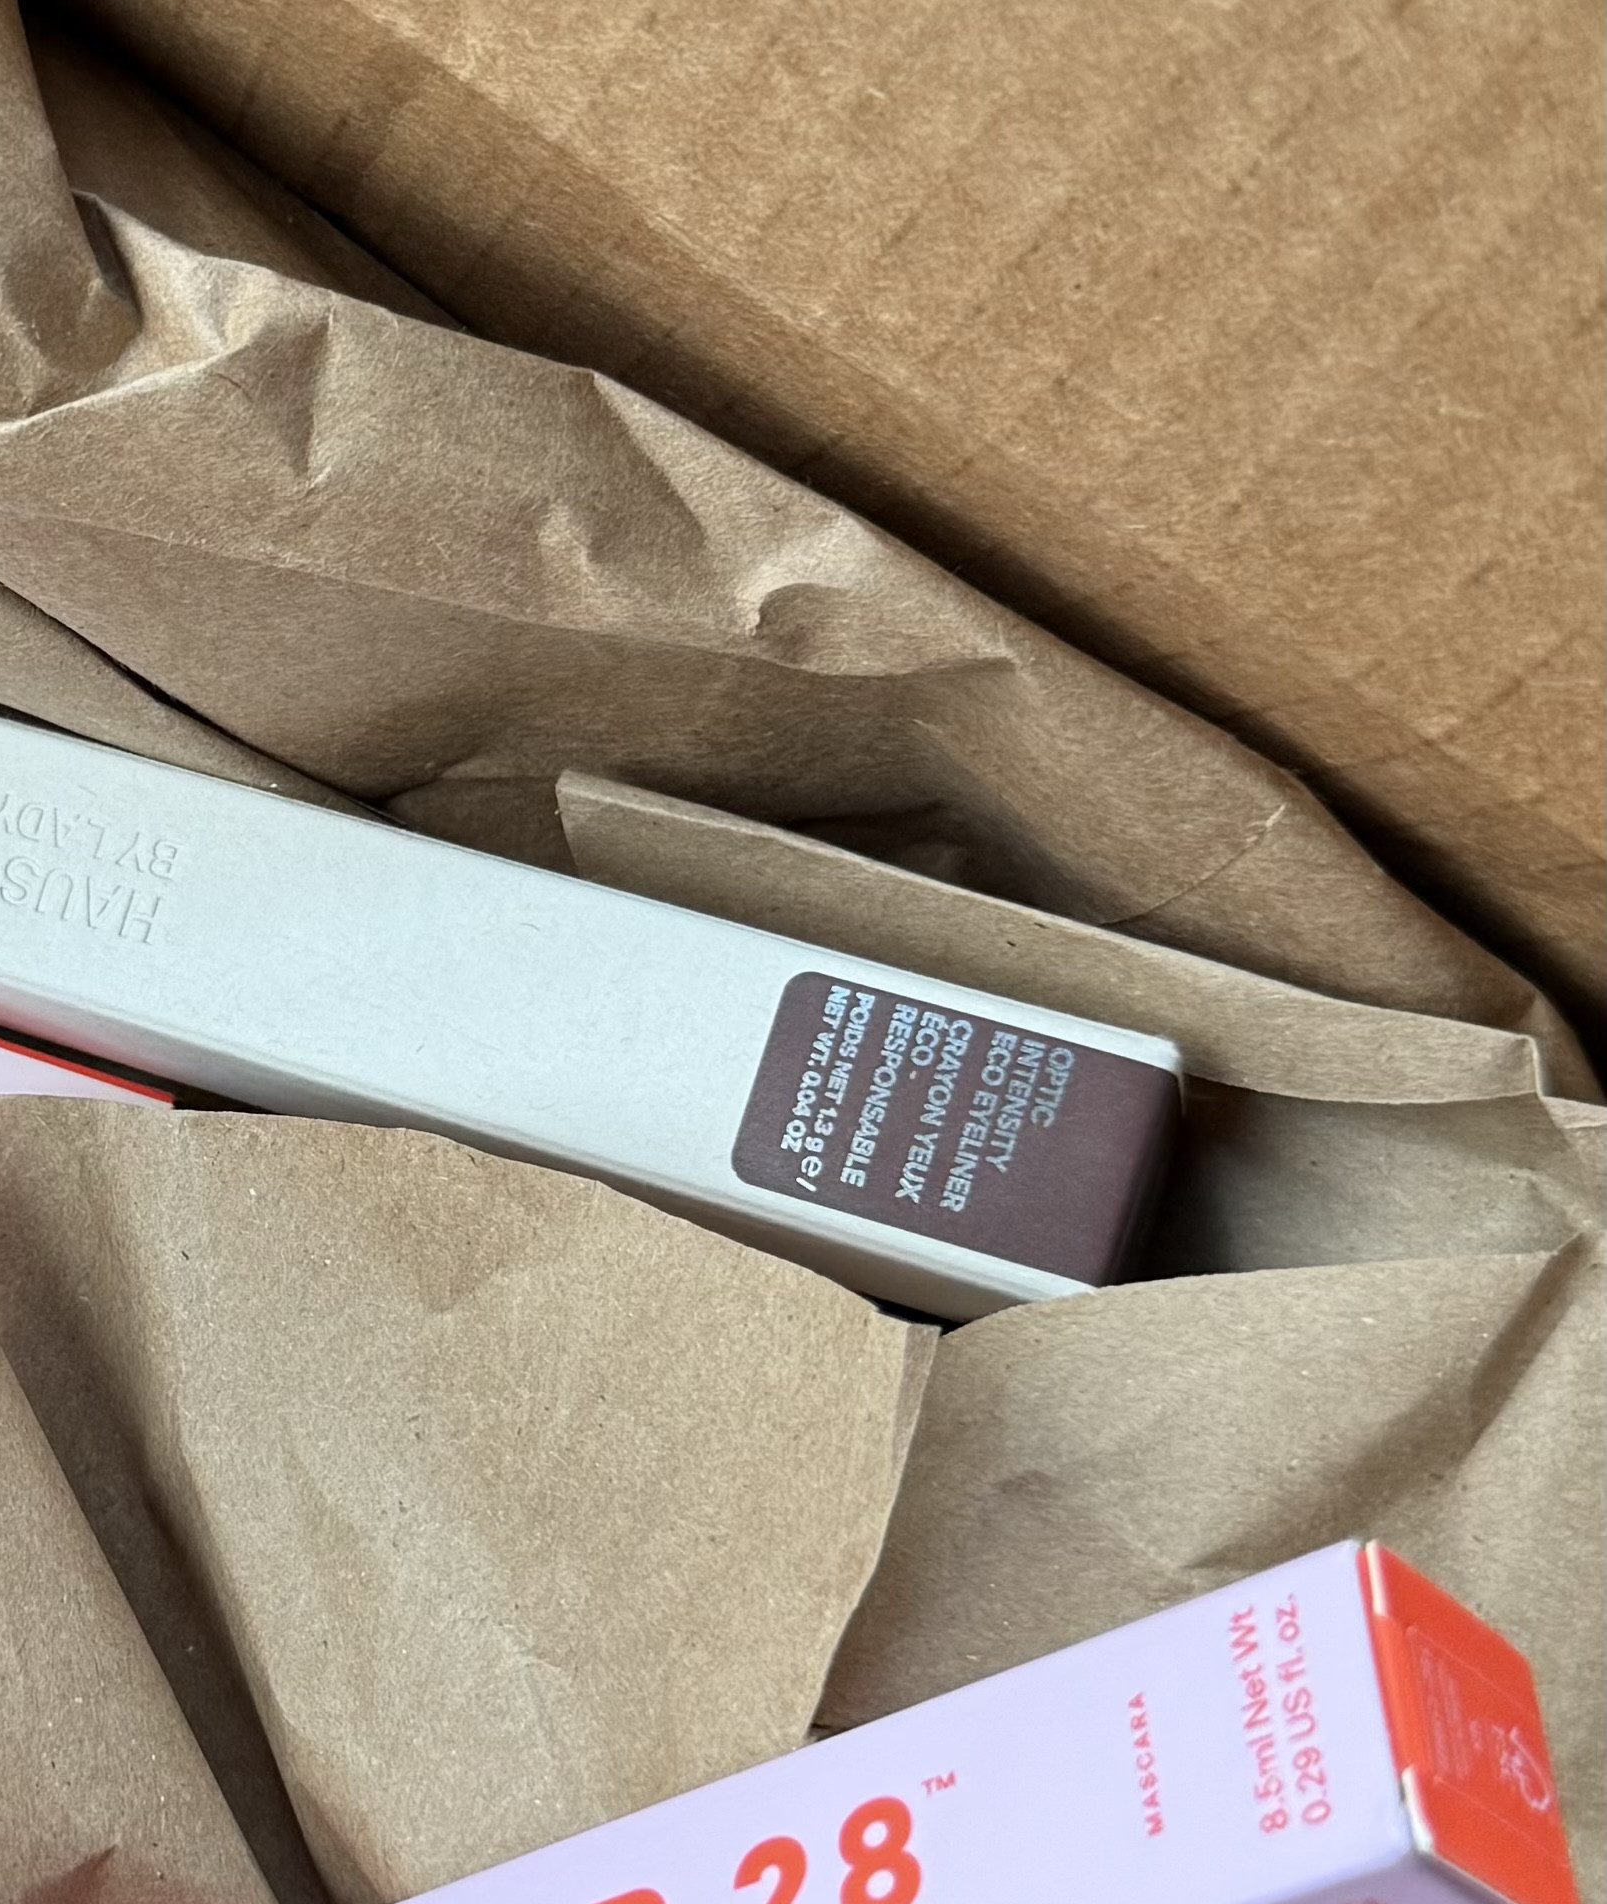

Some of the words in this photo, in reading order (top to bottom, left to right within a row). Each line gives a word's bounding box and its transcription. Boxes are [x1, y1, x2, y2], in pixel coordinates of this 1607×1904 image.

[113, 831, 180, 881] BY
[820, 984, 850, 1030] NET
[839, 991, 876, 1060] POIDS
[909, 1011, 949, 1068] ÉCO
[981, 1029, 1017, 1087] ECO
[790, 1069, 823, 1118] 0.04
[822, 1059, 853, 1105] NET
[840, 1003, 918, 1188] RESPONSABLE
[919, 1017, 974, 1126] CRAYON
[1029, 1045, 1074, 1127] OPTIC
[813, 1103, 839, 1137] 1.3
[985, 1038, 1046, 1173] INTENSITY
[779, 1118, 806, 1153] OZ
[940, 1090, 997, 1212] EYELINER
[894, 1132, 939, 1204] YEUX
[1222, 1603, 1263, 1661] Wt
[1271, 1592, 1303, 1643] oz.
[1274, 1646, 1309, 1683] fl.
[1232, 1663, 1274, 1729] Net
[1279, 1685, 1319, 1741] US
[1128, 1690, 1164, 1836] MASCARA
[1241, 1732, 1292, 1835] 8.5ml
[1288, 1744, 1334, 1827] 0.29
